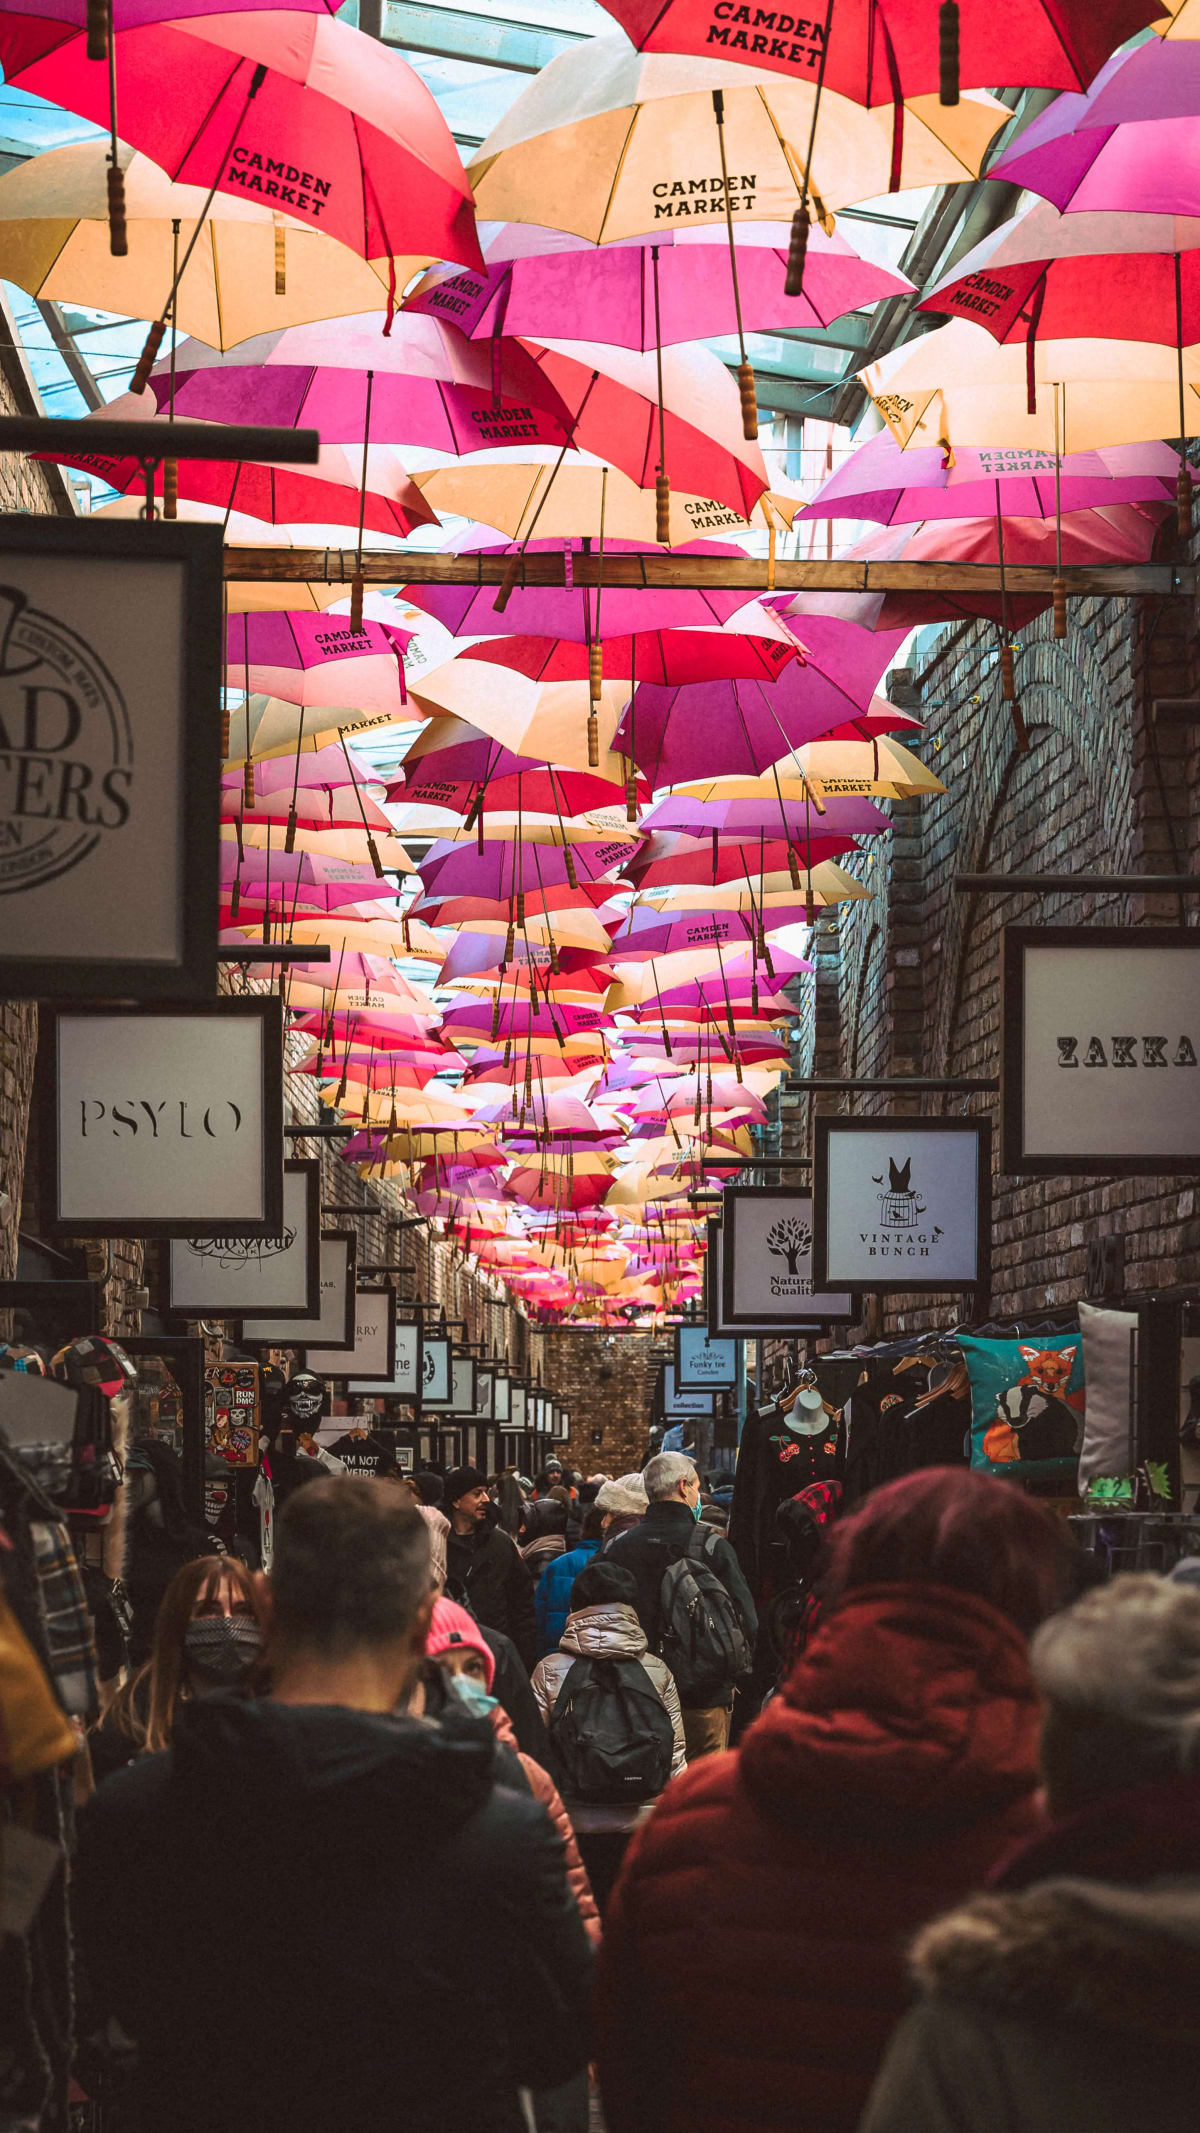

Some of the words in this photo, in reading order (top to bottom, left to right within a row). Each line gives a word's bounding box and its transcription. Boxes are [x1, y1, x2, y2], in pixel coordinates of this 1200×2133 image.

[714, 1, 828, 44] CAMDEN
[706, 25, 823, 67] MARKET
[233, 147, 332, 197] CAMDEN
[228, 166, 326, 216] MARKET
[652, 174, 757, 198] CAMDEN
[654, 195, 757, 219] MARKET
[964, 274, 1016, 302] CAMDEN
[428, 291, 472, 316] MARKET
[950, 290, 1001, 317] MARKET
[472, 407, 534, 423] CAMDEN
[479, 424, 540, 439] MARKET
[684, 500, 727, 514] CAMD
[690, 511, 745, 529] MARKE
[320, 639, 374, 655] MARKET
[338, 713, 393, 735] MARKET
[411, 790, 452, 802] MARKET
[823, 783, 872, 792] MARKET
[601, 845, 636, 866] MARKET
[686, 923, 729, 935] CAMDEN
[687, 931, 729, 942] MARKET
[1057, 1035, 1198, 1068] ZAKKA
[80, 1100, 242, 1138] PSYLO
[859, 1233, 940, 1244] VINTAGE
[868, 1247, 930, 1256] BUNCH
[689, 1360, 713, 1369] Funky
[236, 1390, 255, 1398] RUN
[359, 1456, 380, 1466] NOT
